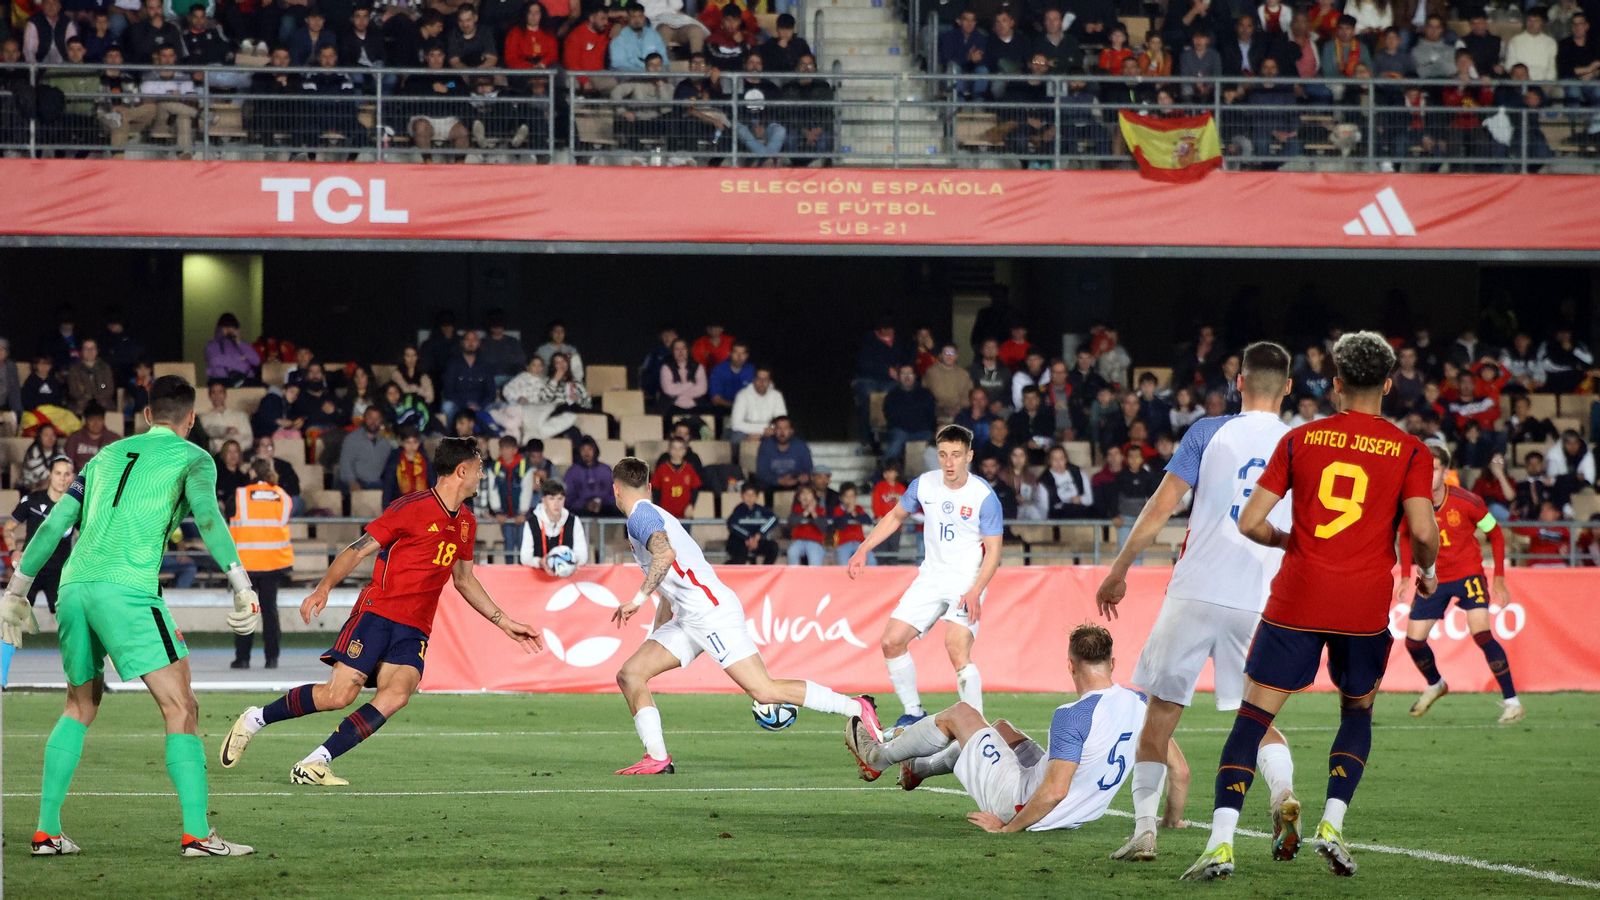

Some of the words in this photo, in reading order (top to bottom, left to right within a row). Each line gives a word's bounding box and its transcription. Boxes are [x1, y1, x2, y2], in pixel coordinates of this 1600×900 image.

[720, 178, 862, 194] SELECCIÓN
[872, 178, 1004, 195] ESPAÑOLA
[261, 176, 409, 224] TCL
[797, 202, 828, 215] DE
[838, 199, 936, 215] FÚTBOL
[819, 221, 907, 235] SUB-21
[1303, 430, 1347, 448] MATEO
[1350, 434, 1401, 457] JOSEPH
[1314, 461, 1368, 539] 9
[939, 522, 955, 541] 16
[1439, 529, 1451, 546] 1
[432, 541, 457, 566] 18
[1464, 577, 1484, 598] 11
[706, 632, 726, 654] 11
[982, 744, 1001, 765] 5
[1097, 731, 1133, 791] 5
